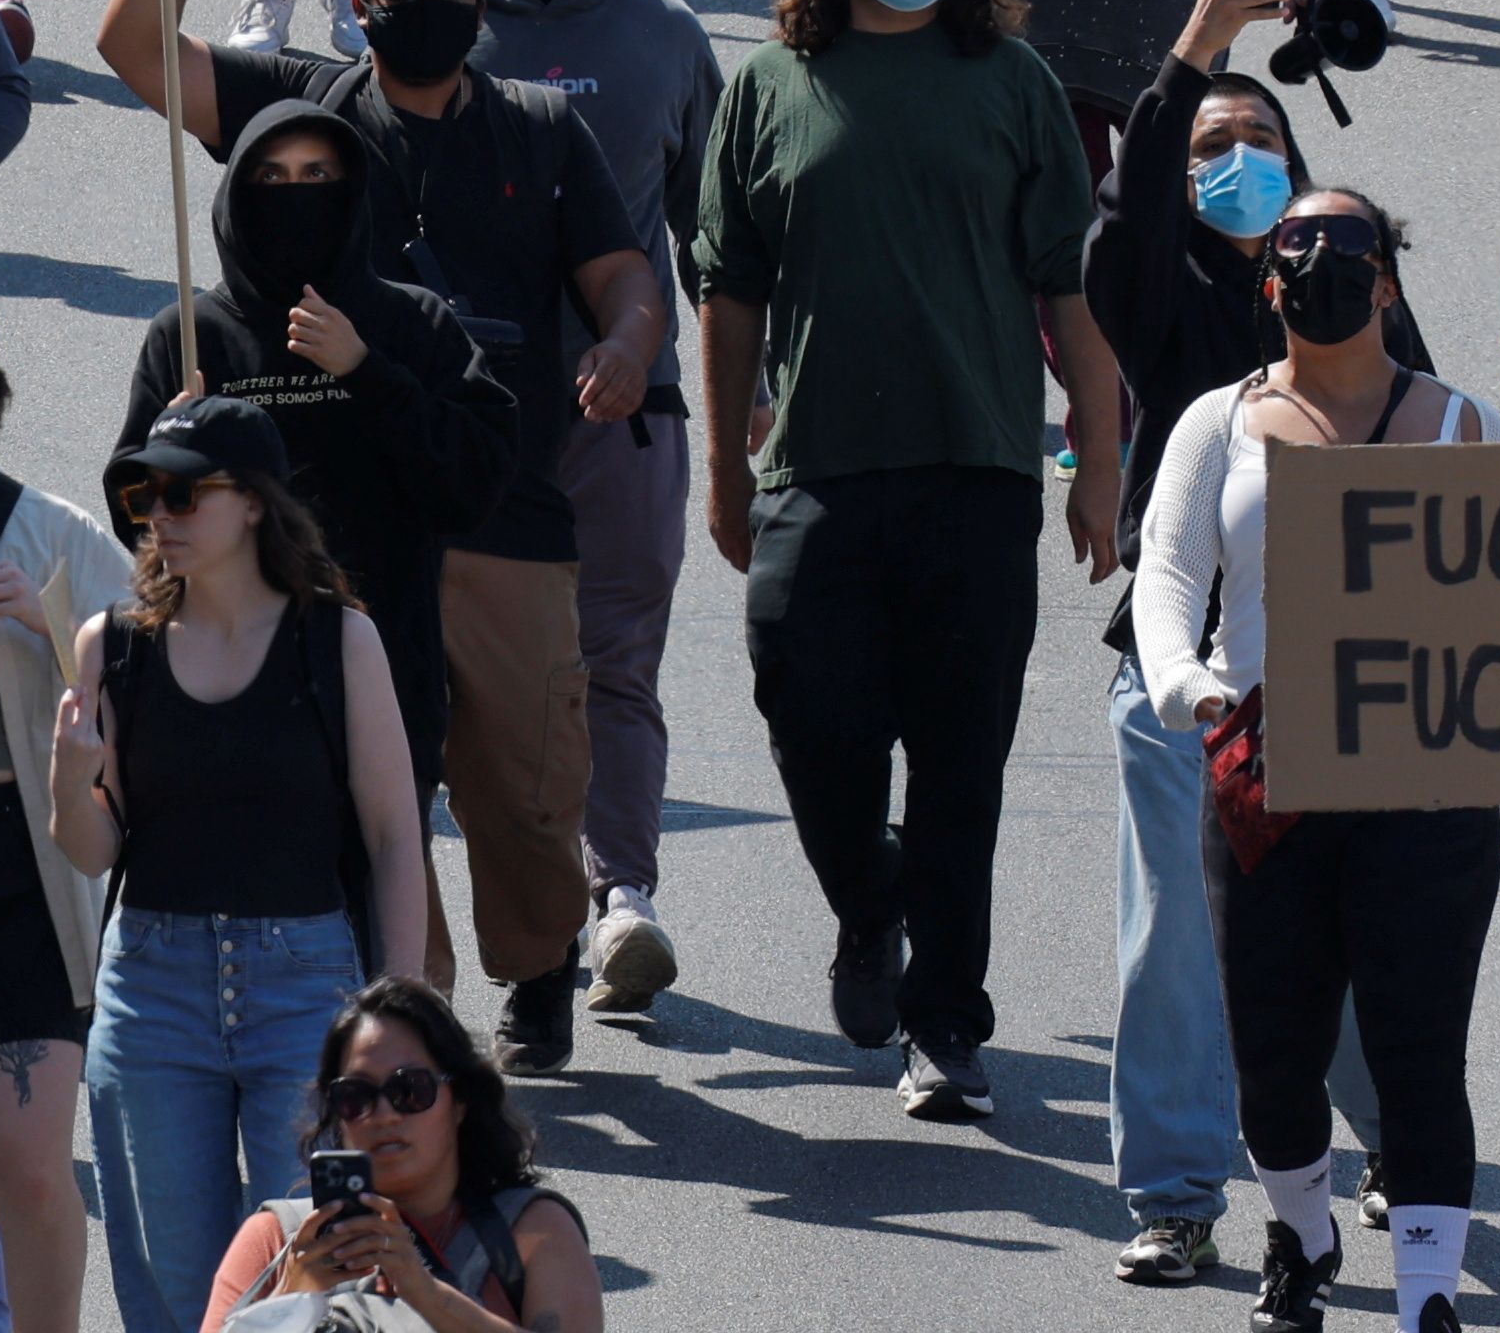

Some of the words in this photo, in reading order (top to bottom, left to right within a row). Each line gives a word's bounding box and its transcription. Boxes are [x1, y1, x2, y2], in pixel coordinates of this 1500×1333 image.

[221, 375, 286, 395] TOGETHER
[289, 374, 309, 388] WE
[311, 373, 337, 386] ARE
[276, 393, 325, 406] SOMOS
